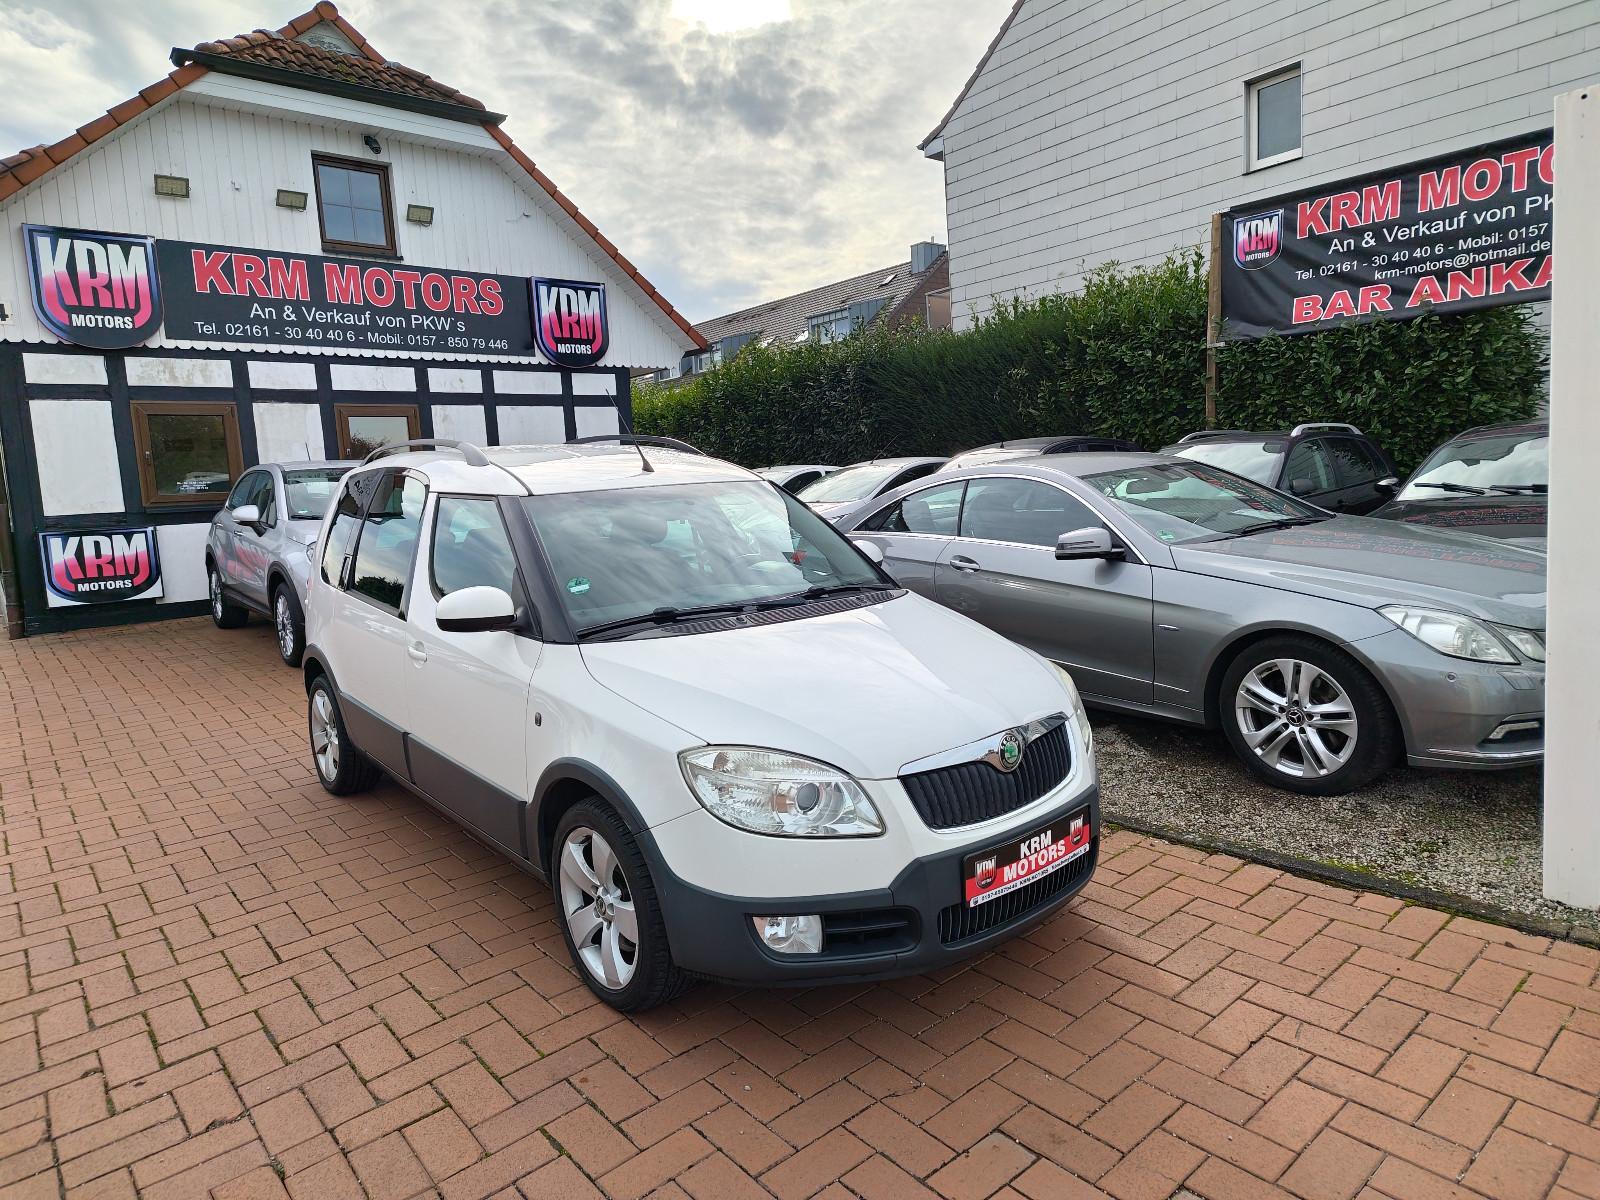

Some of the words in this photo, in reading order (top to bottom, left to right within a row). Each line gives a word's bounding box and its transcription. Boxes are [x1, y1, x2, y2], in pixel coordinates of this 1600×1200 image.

[1296, 180, 1401, 239] KRM
[1328, 238, 1355, 255] An
[1361, 231, 1377, 248] &
[1383, 211, 1468, 243] Verkauf
[1473, 205, 1516, 225] von
[1237, 216, 1279, 261] KRM
[1245, 251, 1270, 261] MOTORS
[1295, 268, 1316, 280] Tel.
[1320, 260, 1358, 276] 02161
[1371, 254, 1388, 267] 30
[1391, 250, 1409, 263] 40
[1413, 246, 1431, 259] 40
[1435, 243, 1444, 255] 6
[1458, 232, 1503, 251] Mobil:
[1508, 222, 1549, 240] 0157
[1374, 240, 1551, 280] krm-motors@hotmail.de
[37, 236, 153, 329] KRM
[191, 249, 311, 301] KRM
[323, 262, 504, 316] MOTORS
[71, 313, 134, 329] MOTORS
[250, 303, 276, 320] An
[283, 305, 297, 321] &
[302, 306, 371, 326] Verkauf
[375, 314, 406, 328] von
[538, 286, 605, 354] KRM
[1291, 283, 1394, 325] BAR
[194, 321, 221, 335] Tel.
[225, 323, 269, 338] 02161
[284, 326, 302, 339] 30
[305, 328, 323, 340] 40
[326, 329, 343, 341] 40
[346, 331, 355, 342] 6
[367, 332, 404, 345] Mobil:
[407, 334, 436, 347] 0157
[447, 336, 469, 348] 850
[471, 338, 486, 349] 79
[488, 339, 508, 350] 446
[557, 343, 592, 355] MOTORS
[49, 533, 150, 592] KRM
[77, 579, 133, 592] MOTORS
[1003, 840, 1066, 883] MOTORS
[1020, 830, 1052, 859] KRM
